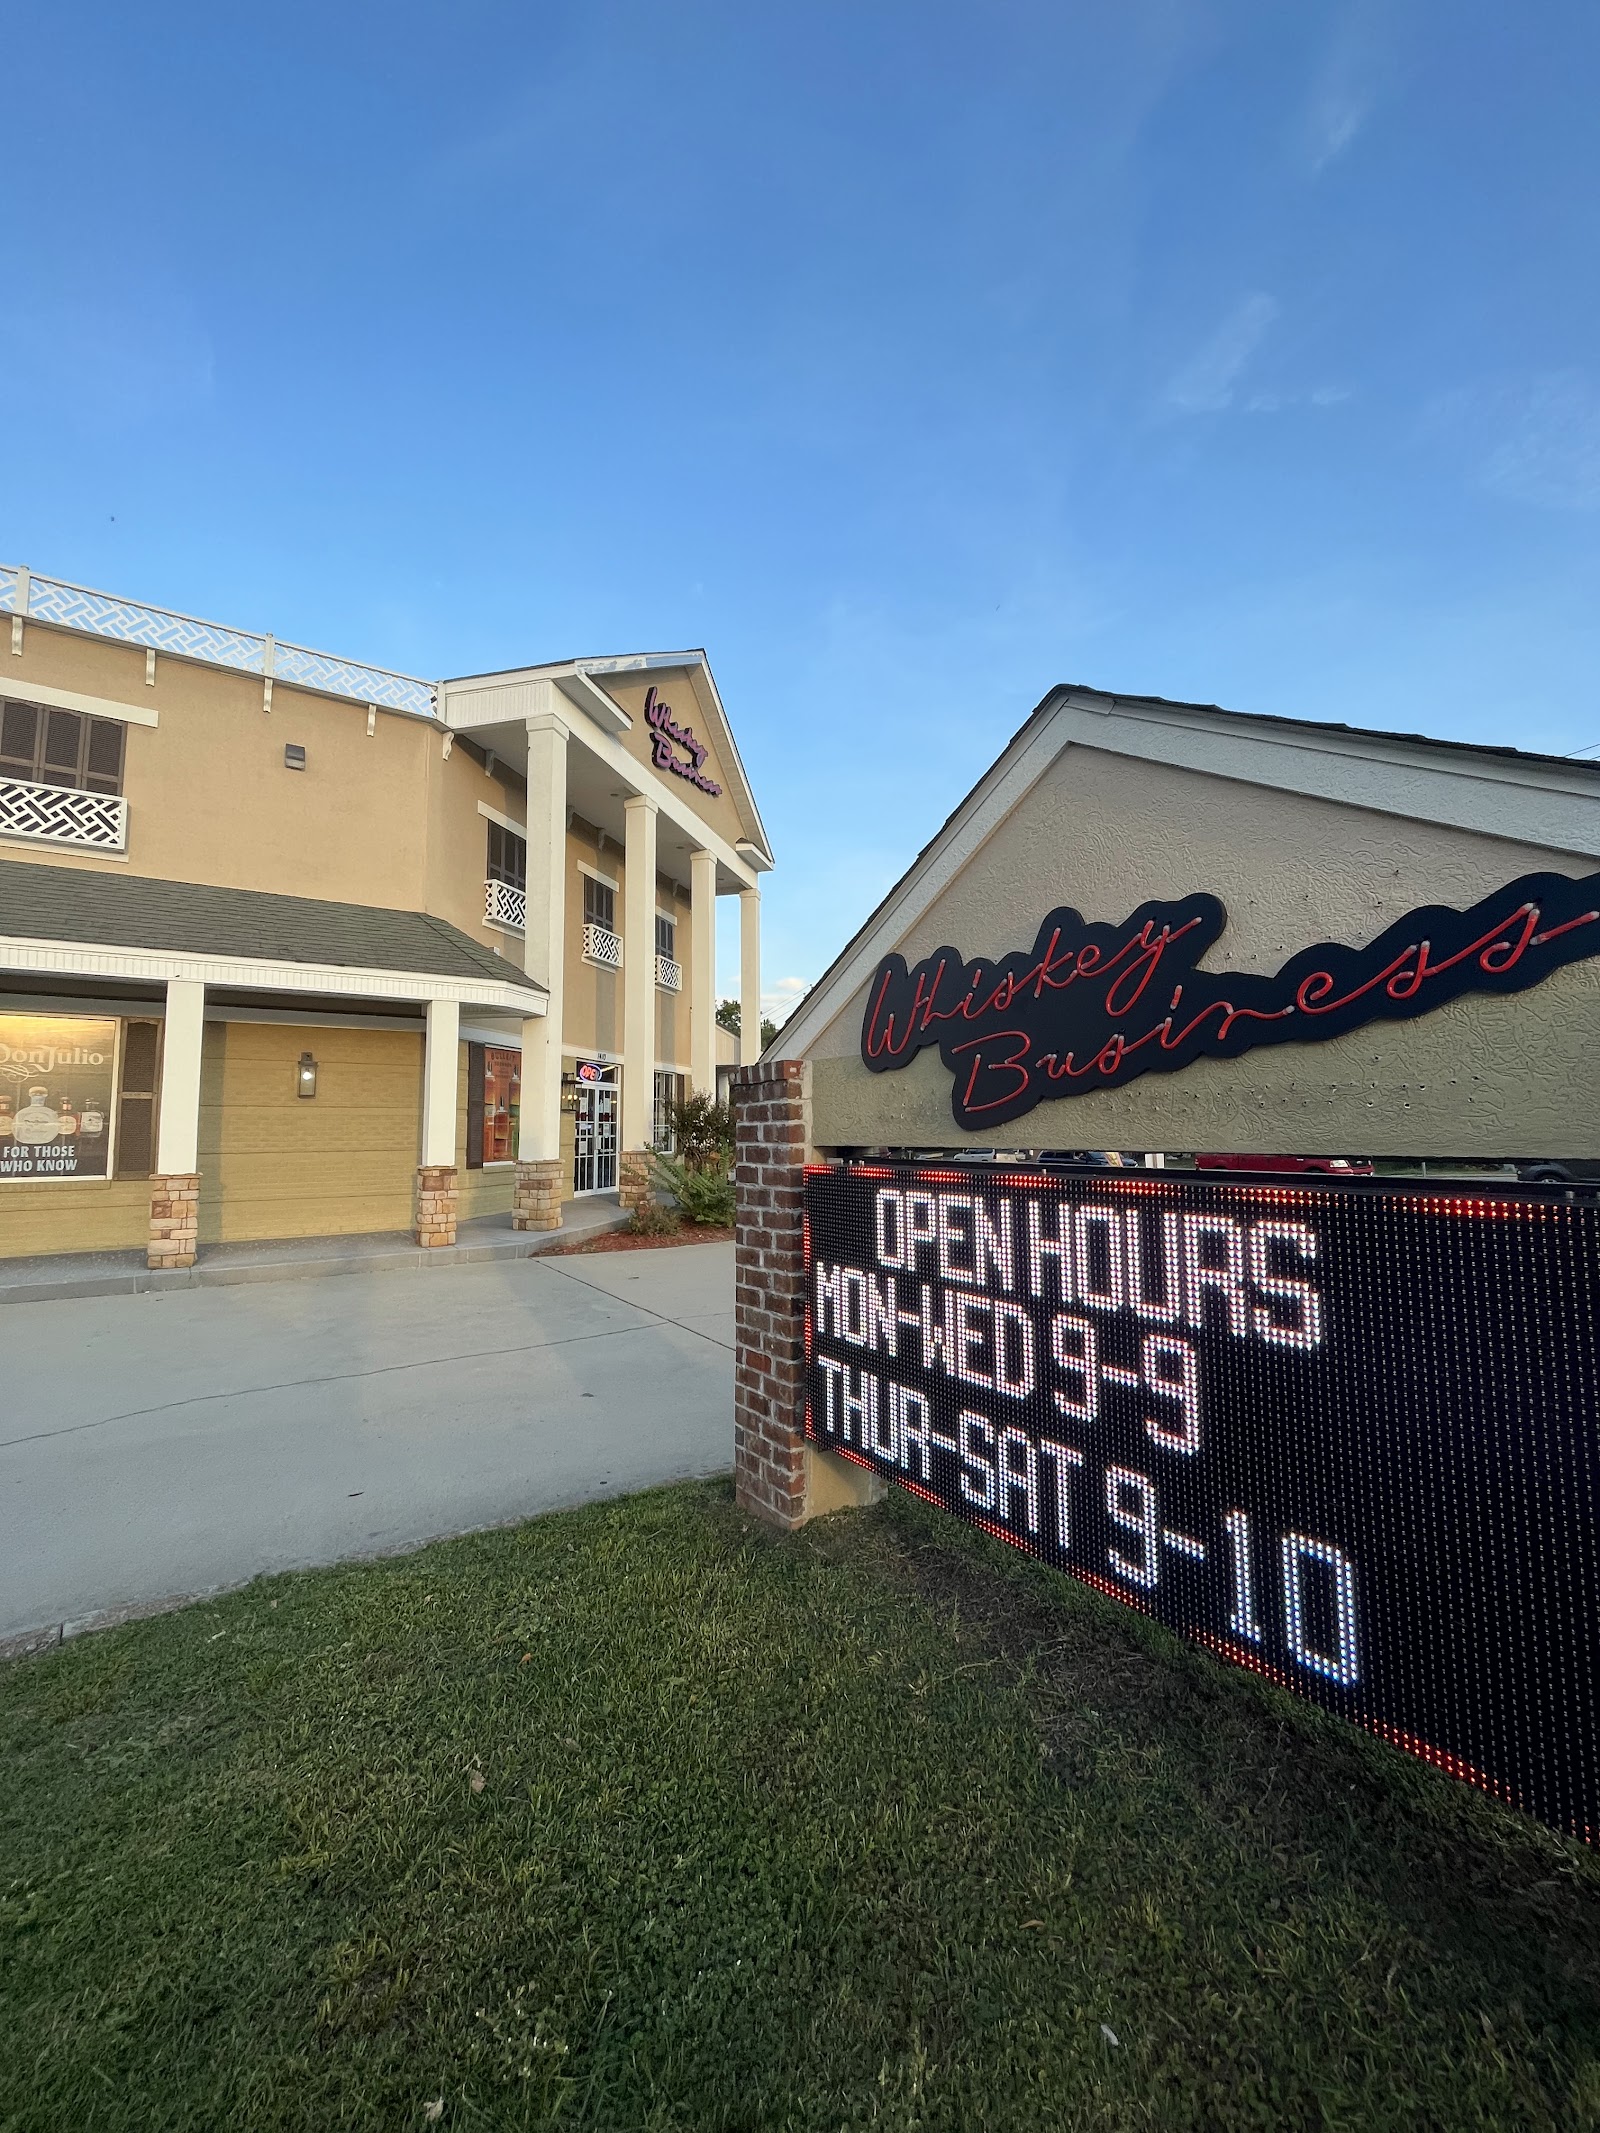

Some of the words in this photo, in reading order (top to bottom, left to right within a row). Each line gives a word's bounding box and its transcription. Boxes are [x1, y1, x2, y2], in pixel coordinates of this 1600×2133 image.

[867, 917, 1202, 1058] Whiskey
[952, 901, 1600, 1113] Business
[580, 1065, 601, 1081] OPE
[0, 1160, 33, 1173] WHO
[36, 1159, 78, 1172] KNOW
[3, 1146, 29, 1158] FOR
[34, 1145, 75, 1158] THOSE
[875, 1188, 1014, 1296] OPEN
[1028, 1200, 1321, 1351] HOURS
[816, 1261, 1036, 1400] MON-WED
[1052, 1314, 1201, 1456] 9-9
[817, 1354, 1083, 1550] THUR-SAT
[1106, 1463, 1359, 1687] 9-10
